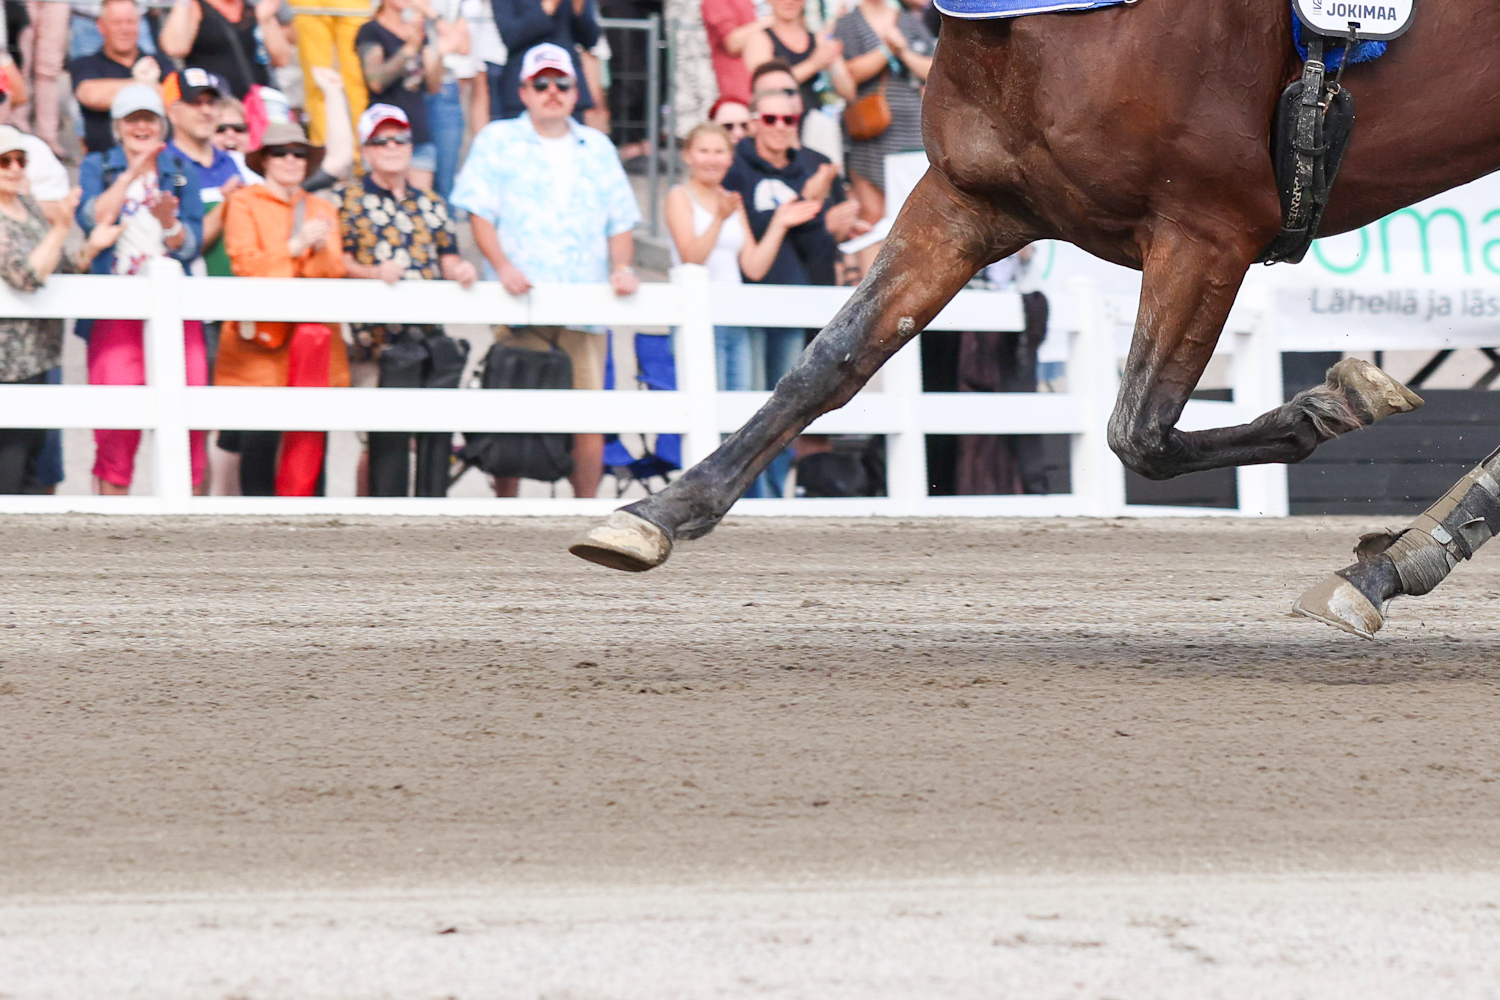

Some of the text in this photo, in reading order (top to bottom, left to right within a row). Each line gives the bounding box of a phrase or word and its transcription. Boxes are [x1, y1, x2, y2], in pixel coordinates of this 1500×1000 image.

[1326, 2, 1397, 21] JOKIMAA
[1310, 286, 1416, 315] Lähellä
[1425, 290, 1453, 321] ja
